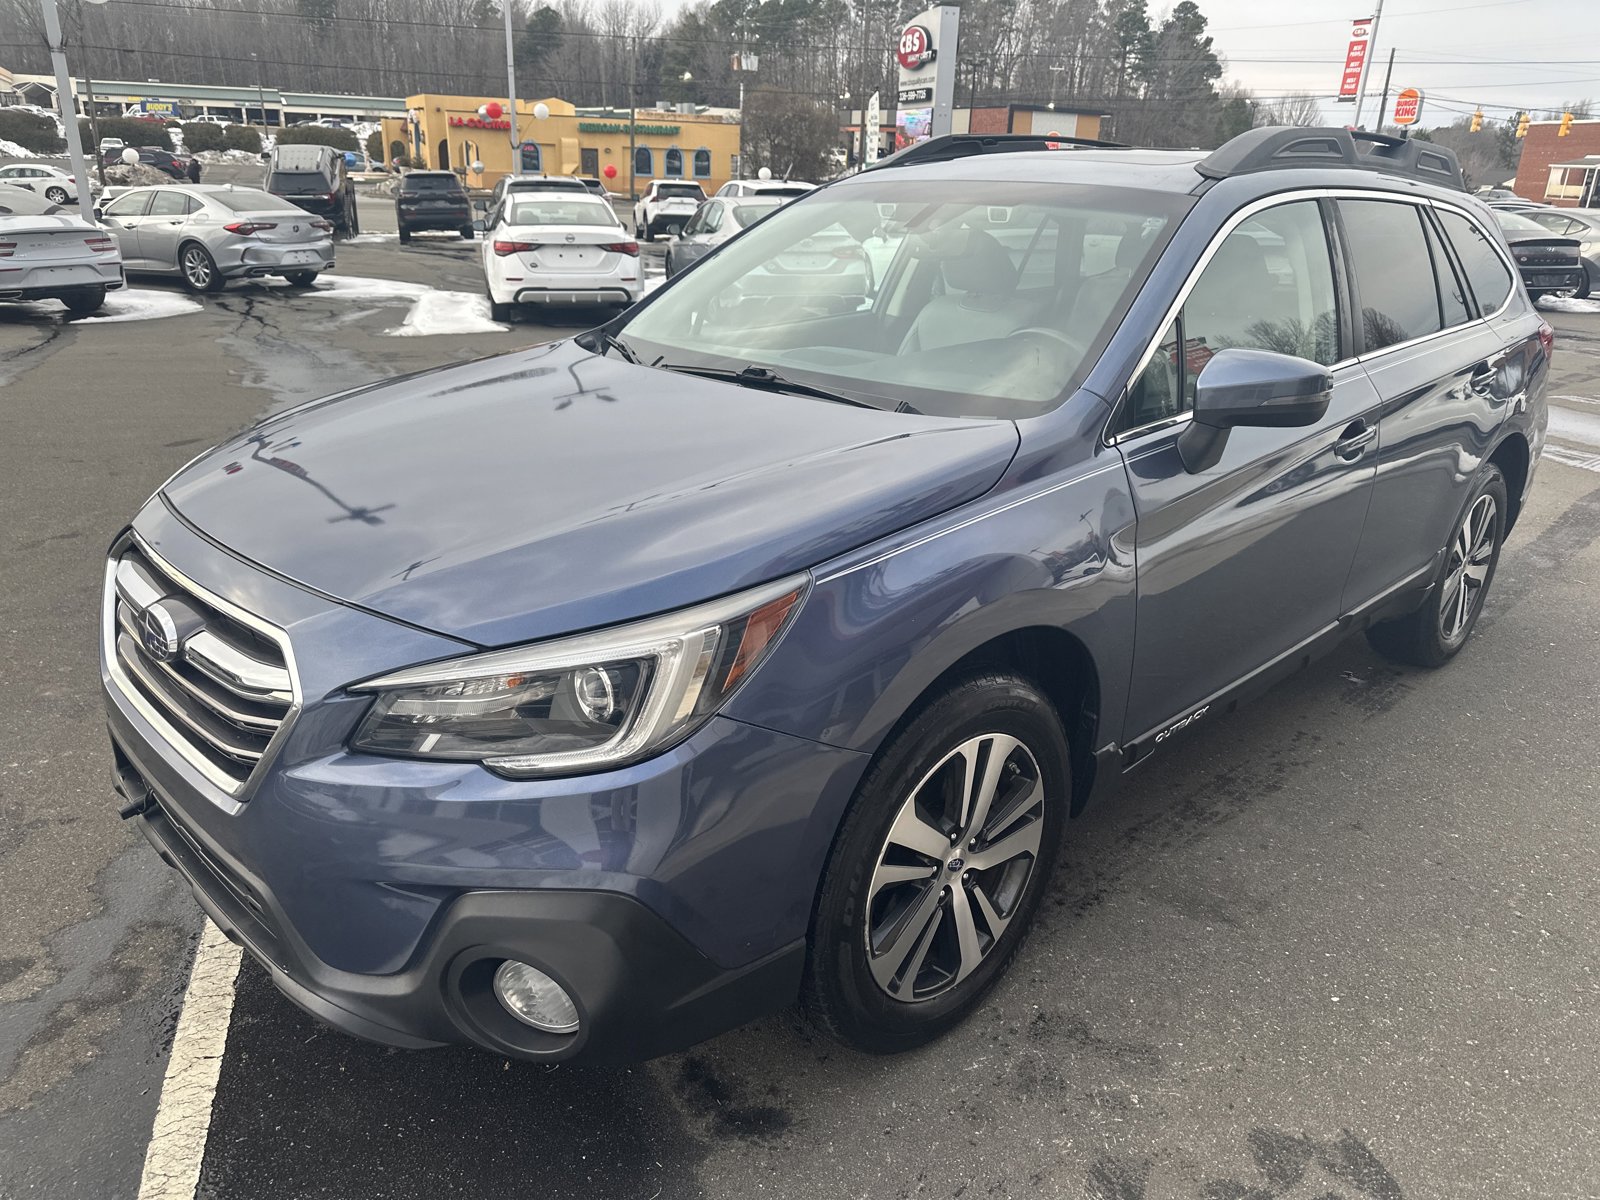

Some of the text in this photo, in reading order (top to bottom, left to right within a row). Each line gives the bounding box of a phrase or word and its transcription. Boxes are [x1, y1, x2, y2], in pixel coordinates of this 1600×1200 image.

[900, 31, 920, 54] CBS
[146, 102, 173, 112] BUDDY'S
[1396, 99, 1418, 107] BURGER
[1394, 107, 1416, 117] KING
[449, 116, 512, 129] LA COCINA
[623, 124, 681, 135] RSTAURANT
